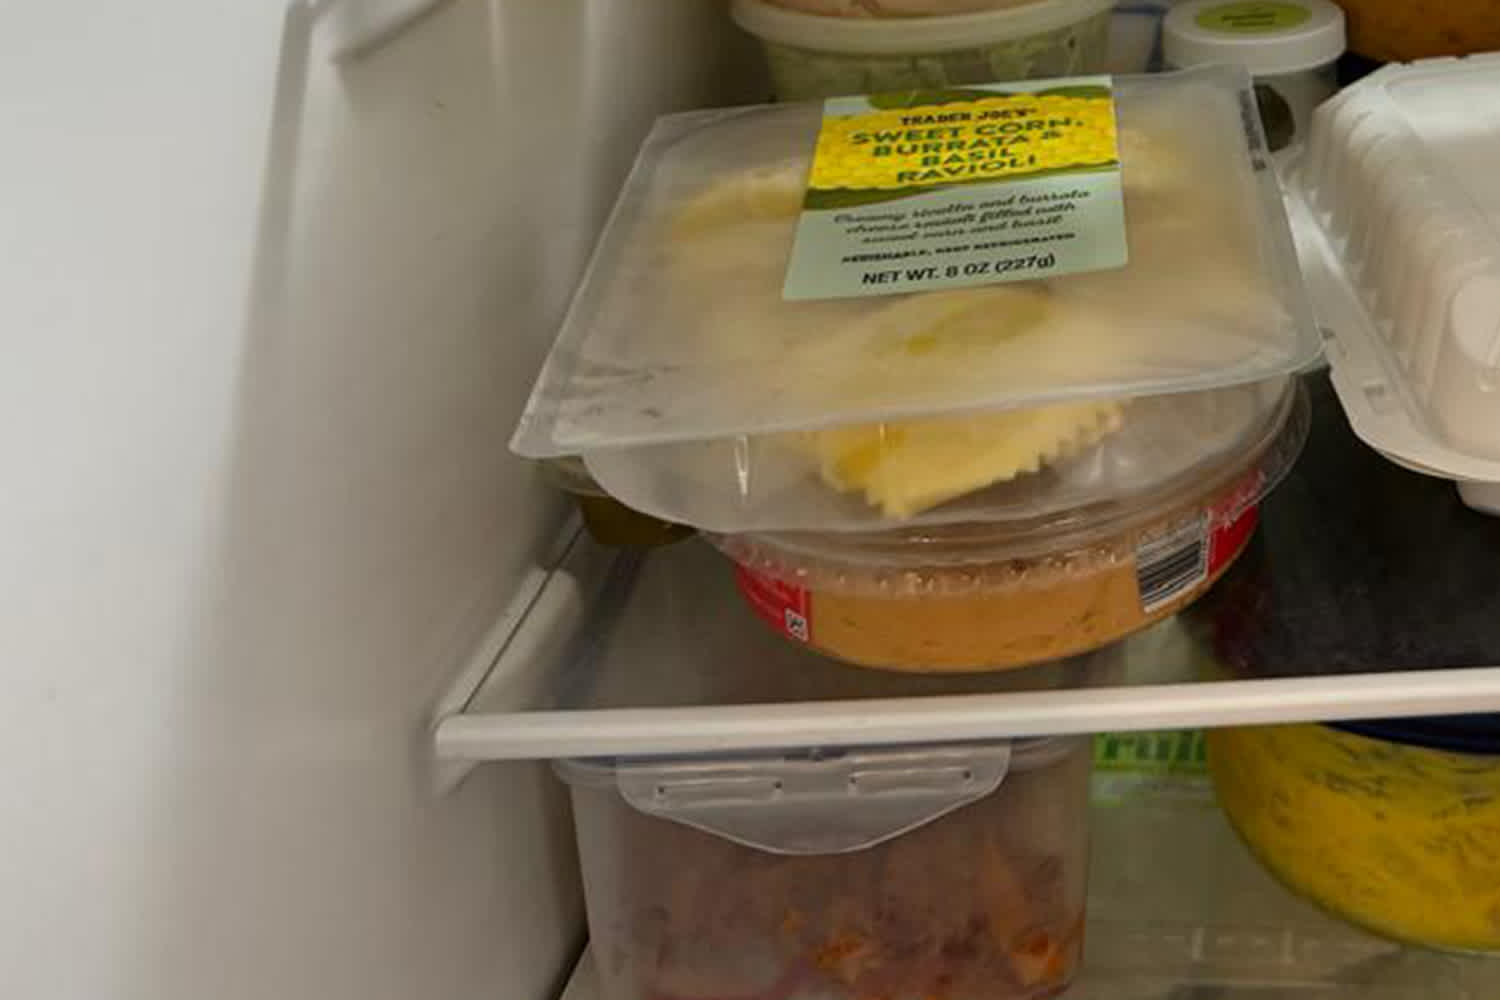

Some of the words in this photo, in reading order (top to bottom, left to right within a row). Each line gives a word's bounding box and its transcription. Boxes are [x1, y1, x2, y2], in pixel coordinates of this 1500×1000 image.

[901, 111, 972, 126] TRADER
[852, 126, 968, 144] SWEET
[871, 134, 1030, 158] BURRATA
[897, 154, 1037, 183] RAVIOLI
[921, 147, 1015, 168] BASIL
[861, 269, 902, 286] NET
[905, 267, 941, 283] WT.
[944, 265, 960, 278] 8
[963, 262, 992, 277] OZ
[995, 252, 1057, 275] (227g)
